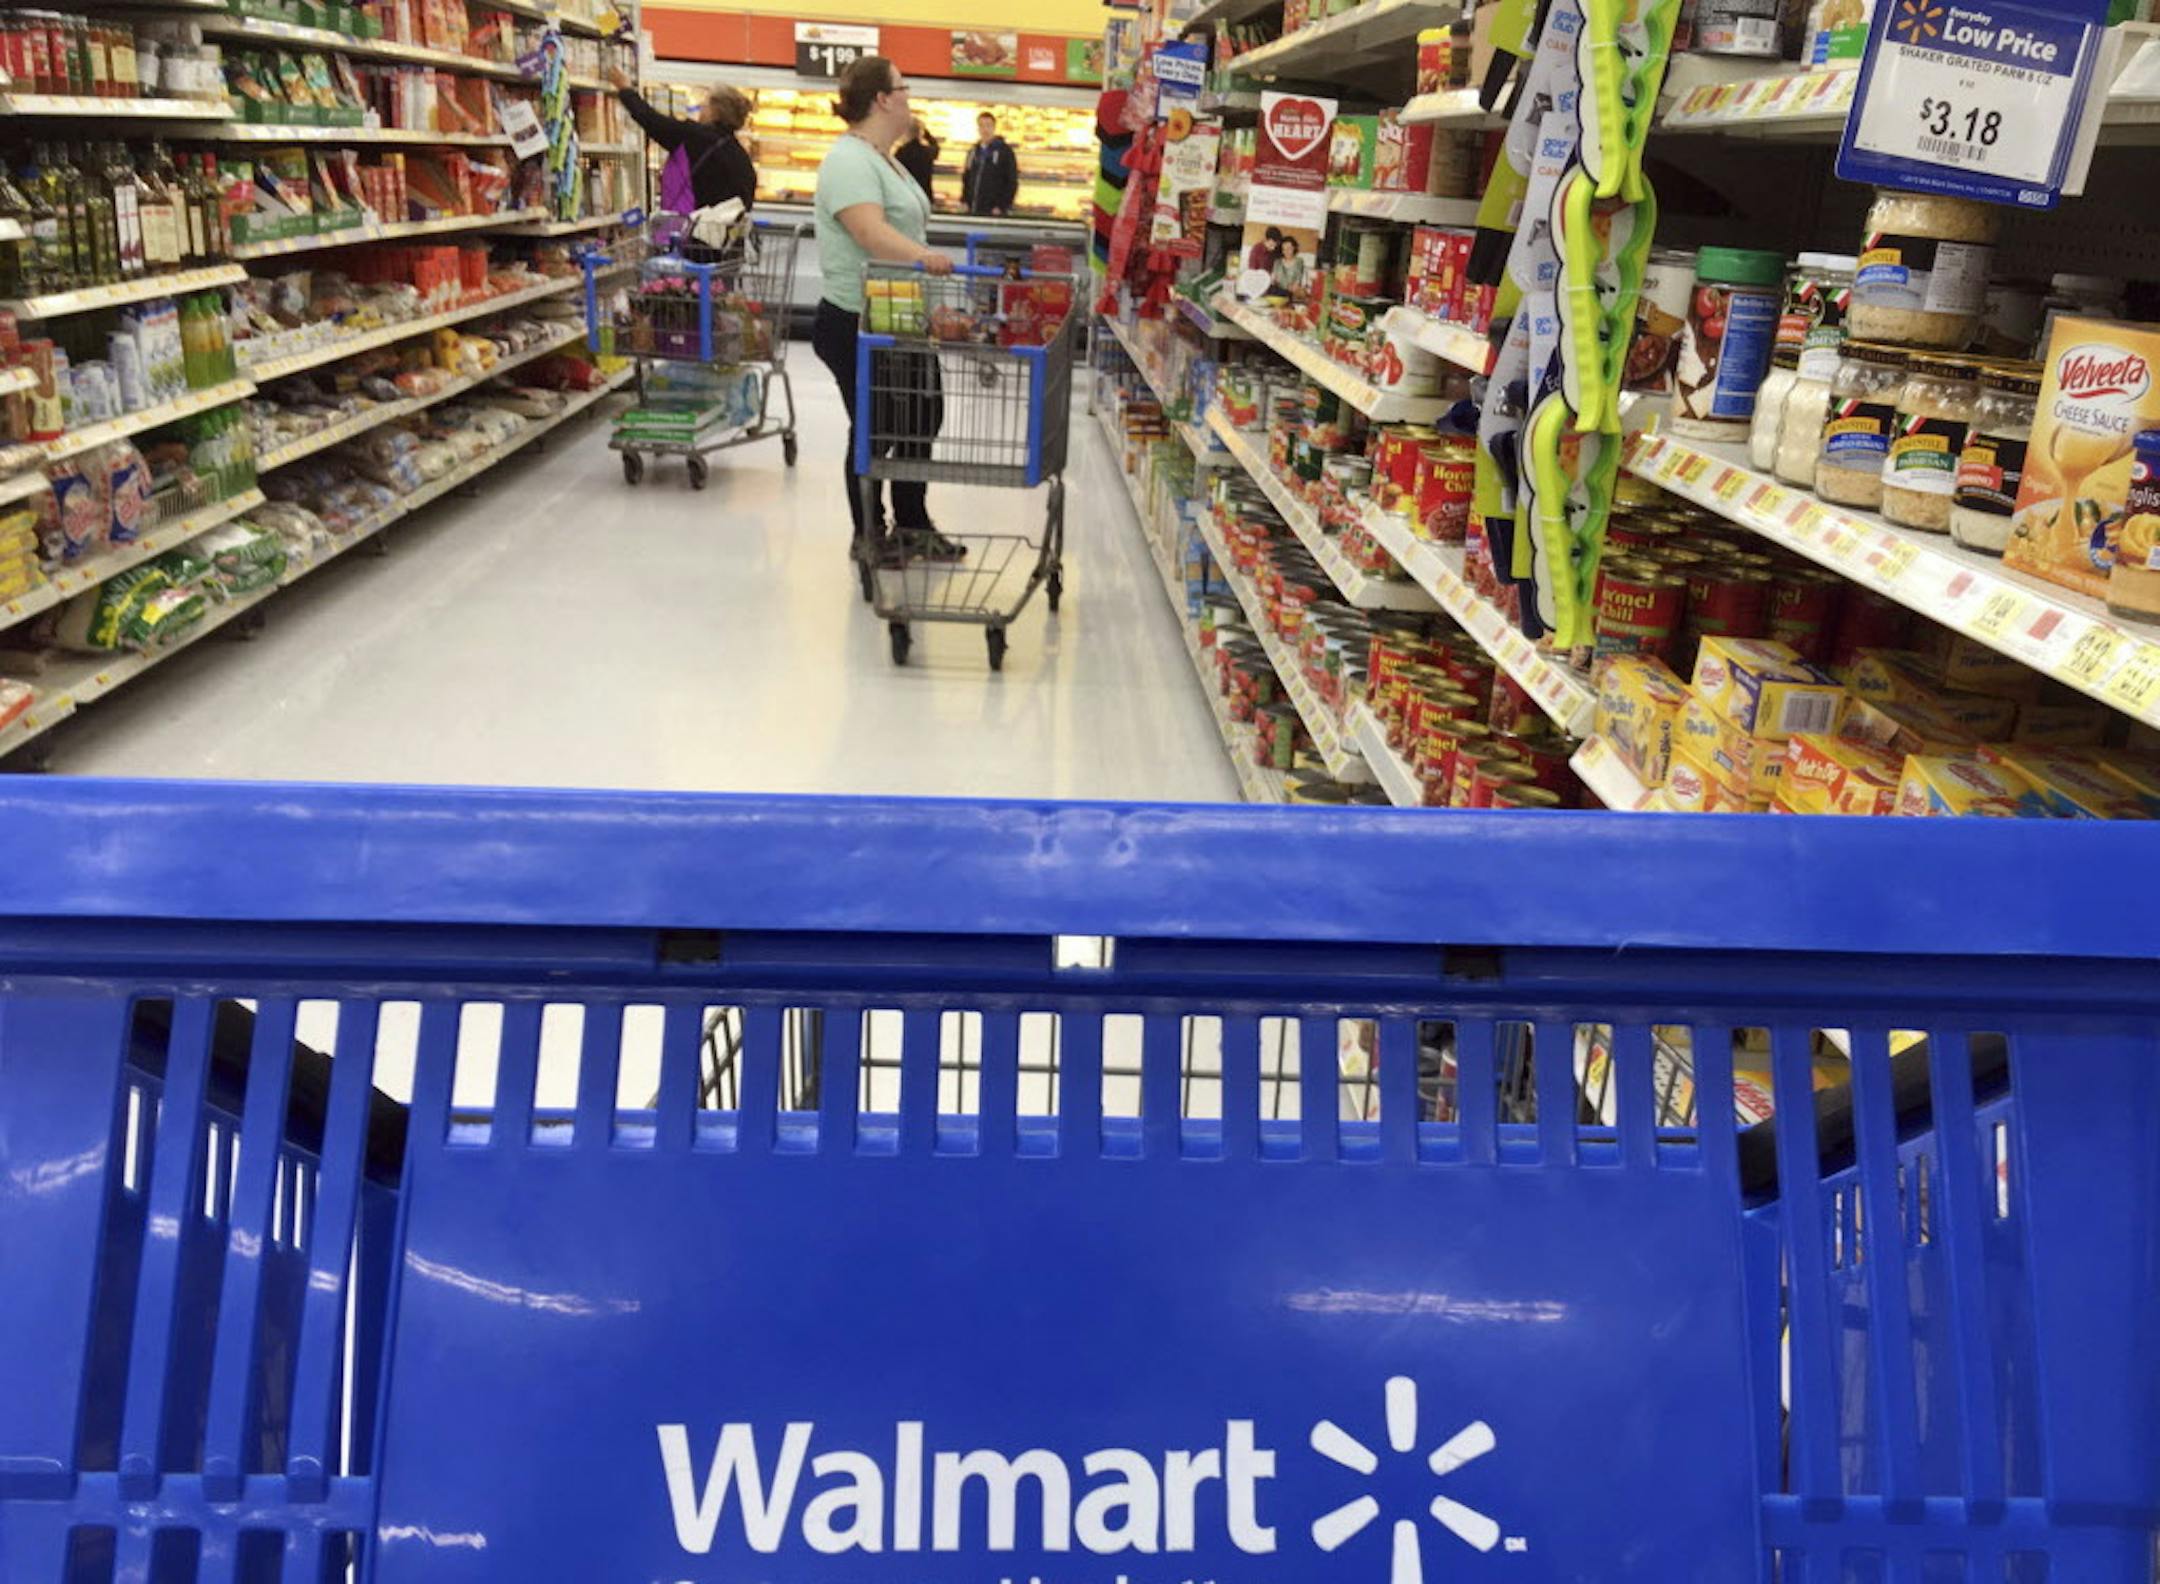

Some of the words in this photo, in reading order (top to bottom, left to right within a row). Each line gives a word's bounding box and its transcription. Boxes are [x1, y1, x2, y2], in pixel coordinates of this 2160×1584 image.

[1949, 6, 1992, 26] Everyday
[1943, 18, 1994, 49] Low
[1997, 28, 2058, 62] Price
[1899, 46, 1945, 65] SHAKER
[1946, 56, 1992, 73] GRATED
[1993, 65, 2026, 80] PARM
[1272, 123, 1322, 139] HEART
[1920, 97, 2003, 146] $3.18
[2060, 354, 2146, 391] Velveeta
[2054, 400, 2090, 424] CHEESE
[2091, 408, 2130, 433] SAUCE
[657, 1419, 1276, 1554] Walmart
